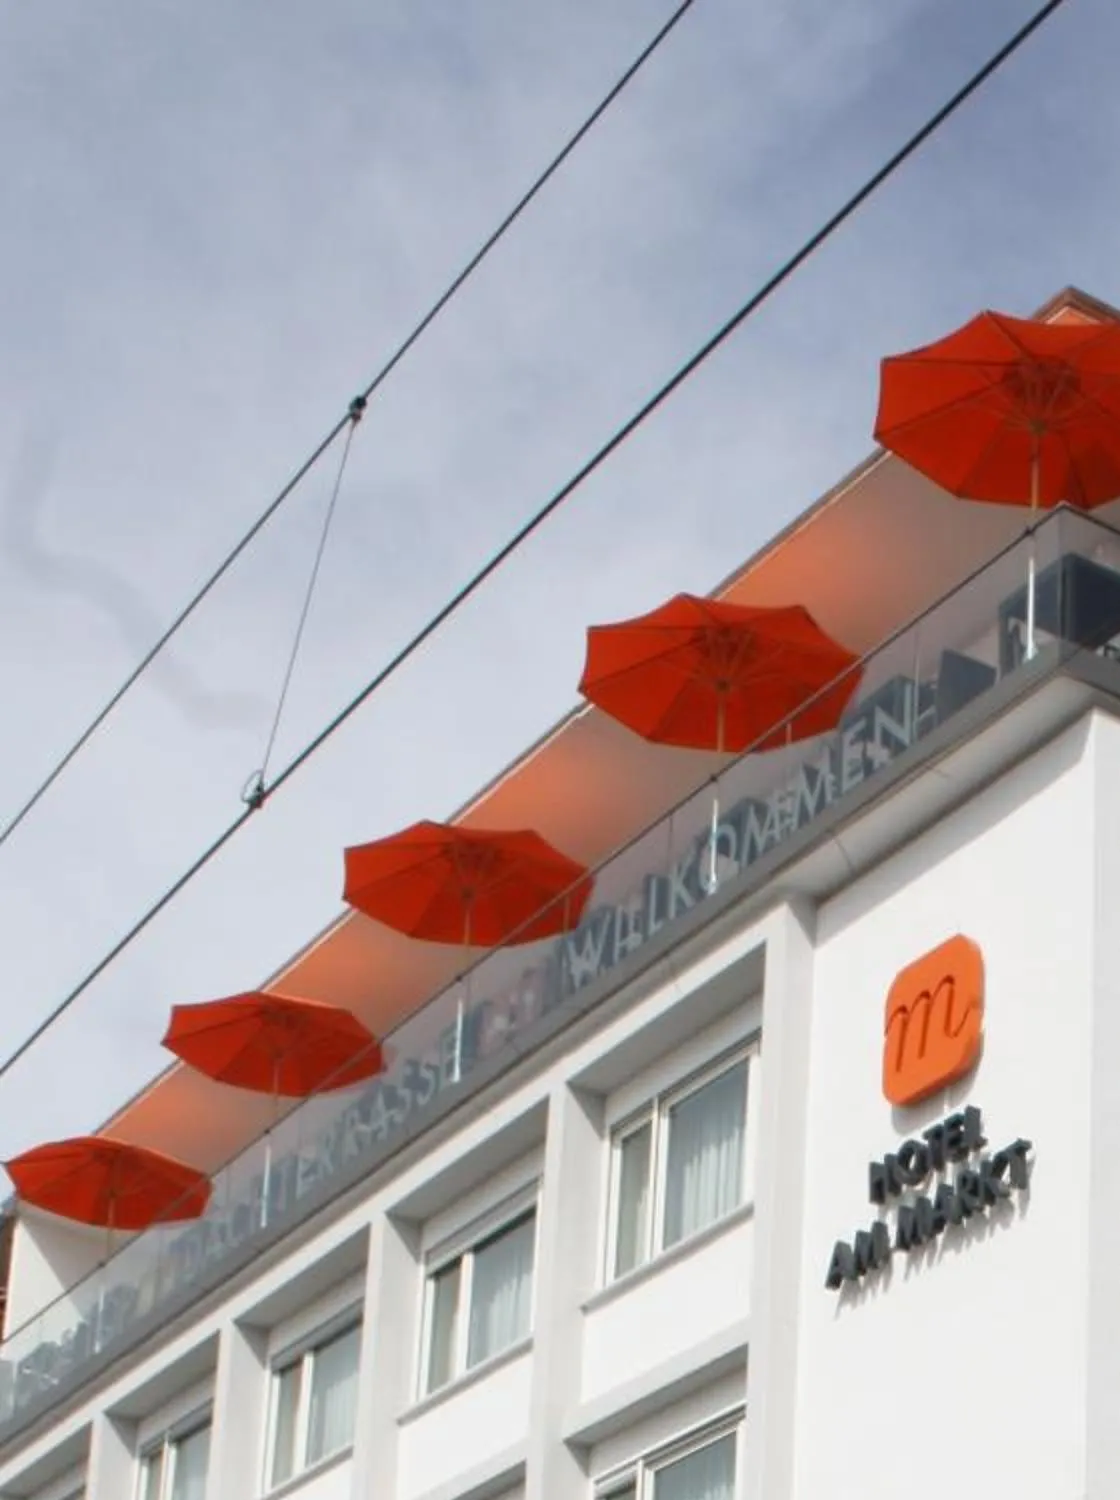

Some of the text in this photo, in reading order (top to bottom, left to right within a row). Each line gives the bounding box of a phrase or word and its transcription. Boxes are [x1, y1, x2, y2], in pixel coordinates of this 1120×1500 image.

[565, 682, 912, 992] WILLKOMMEN
[825, 1138, 1032, 1291] AM MARKT
[869, 1105, 987, 1204] HOTEL
